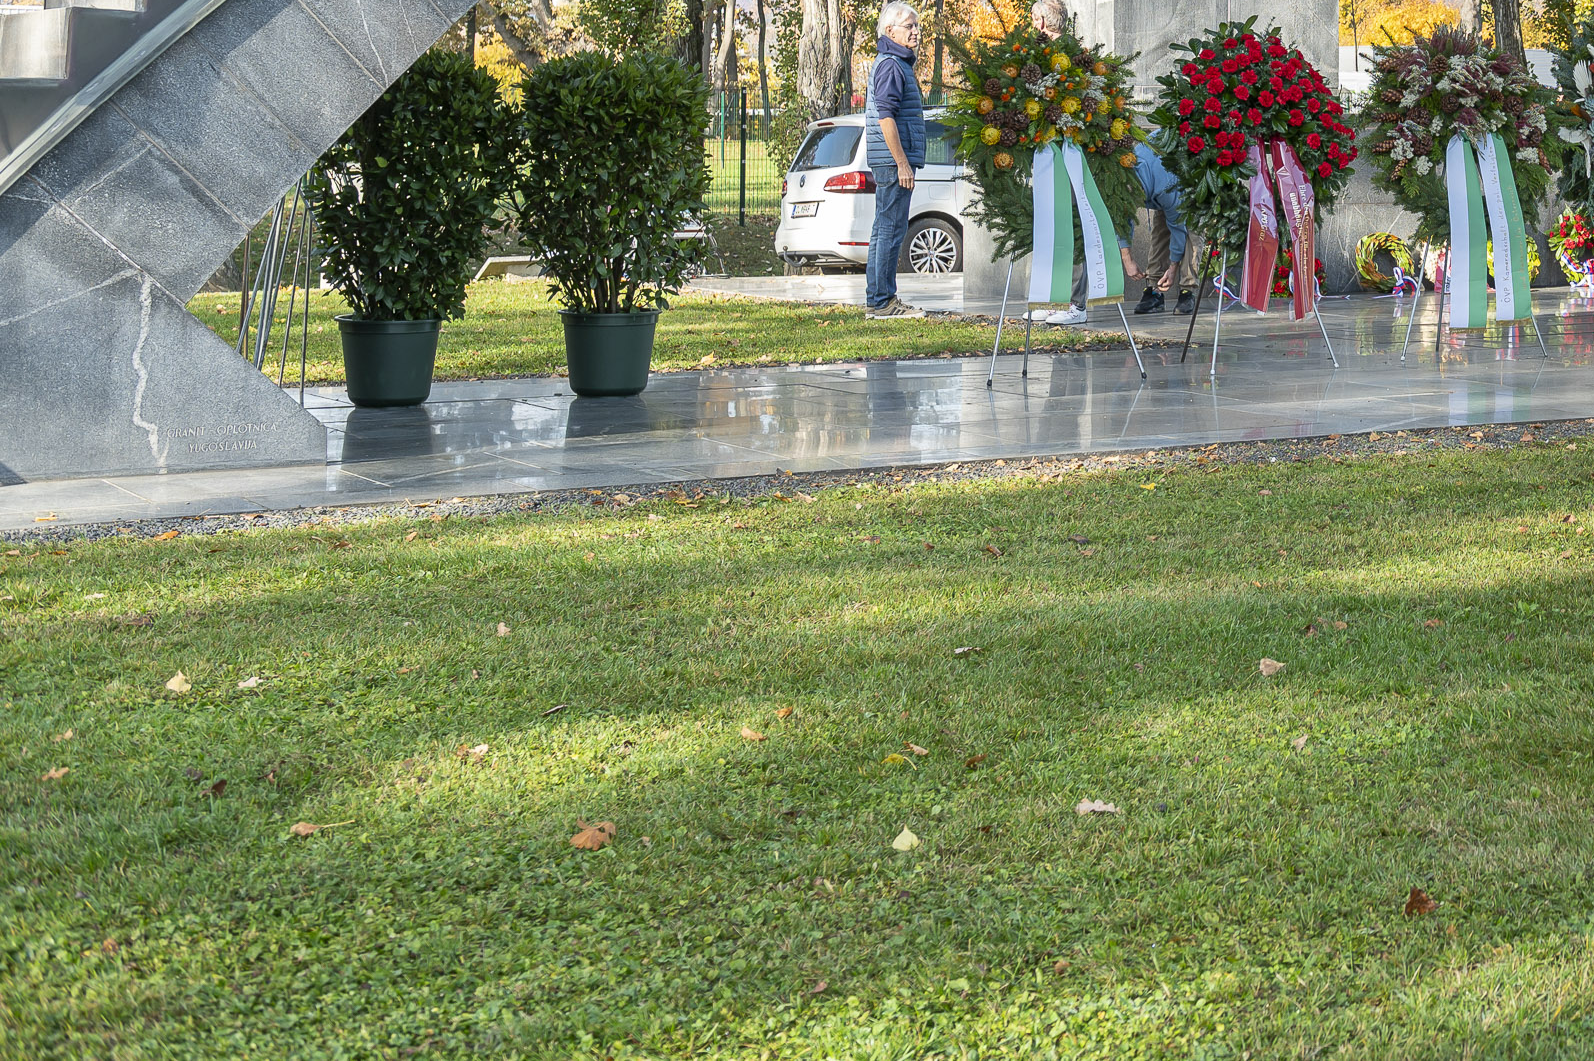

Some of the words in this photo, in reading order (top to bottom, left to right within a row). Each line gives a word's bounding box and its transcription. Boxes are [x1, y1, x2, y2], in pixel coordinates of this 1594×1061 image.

[1500, 286, 1511, 303] ÖVP
[167, 426, 205, 438] GRANIT
[216, 422, 278, 436] OPLOTNICA
